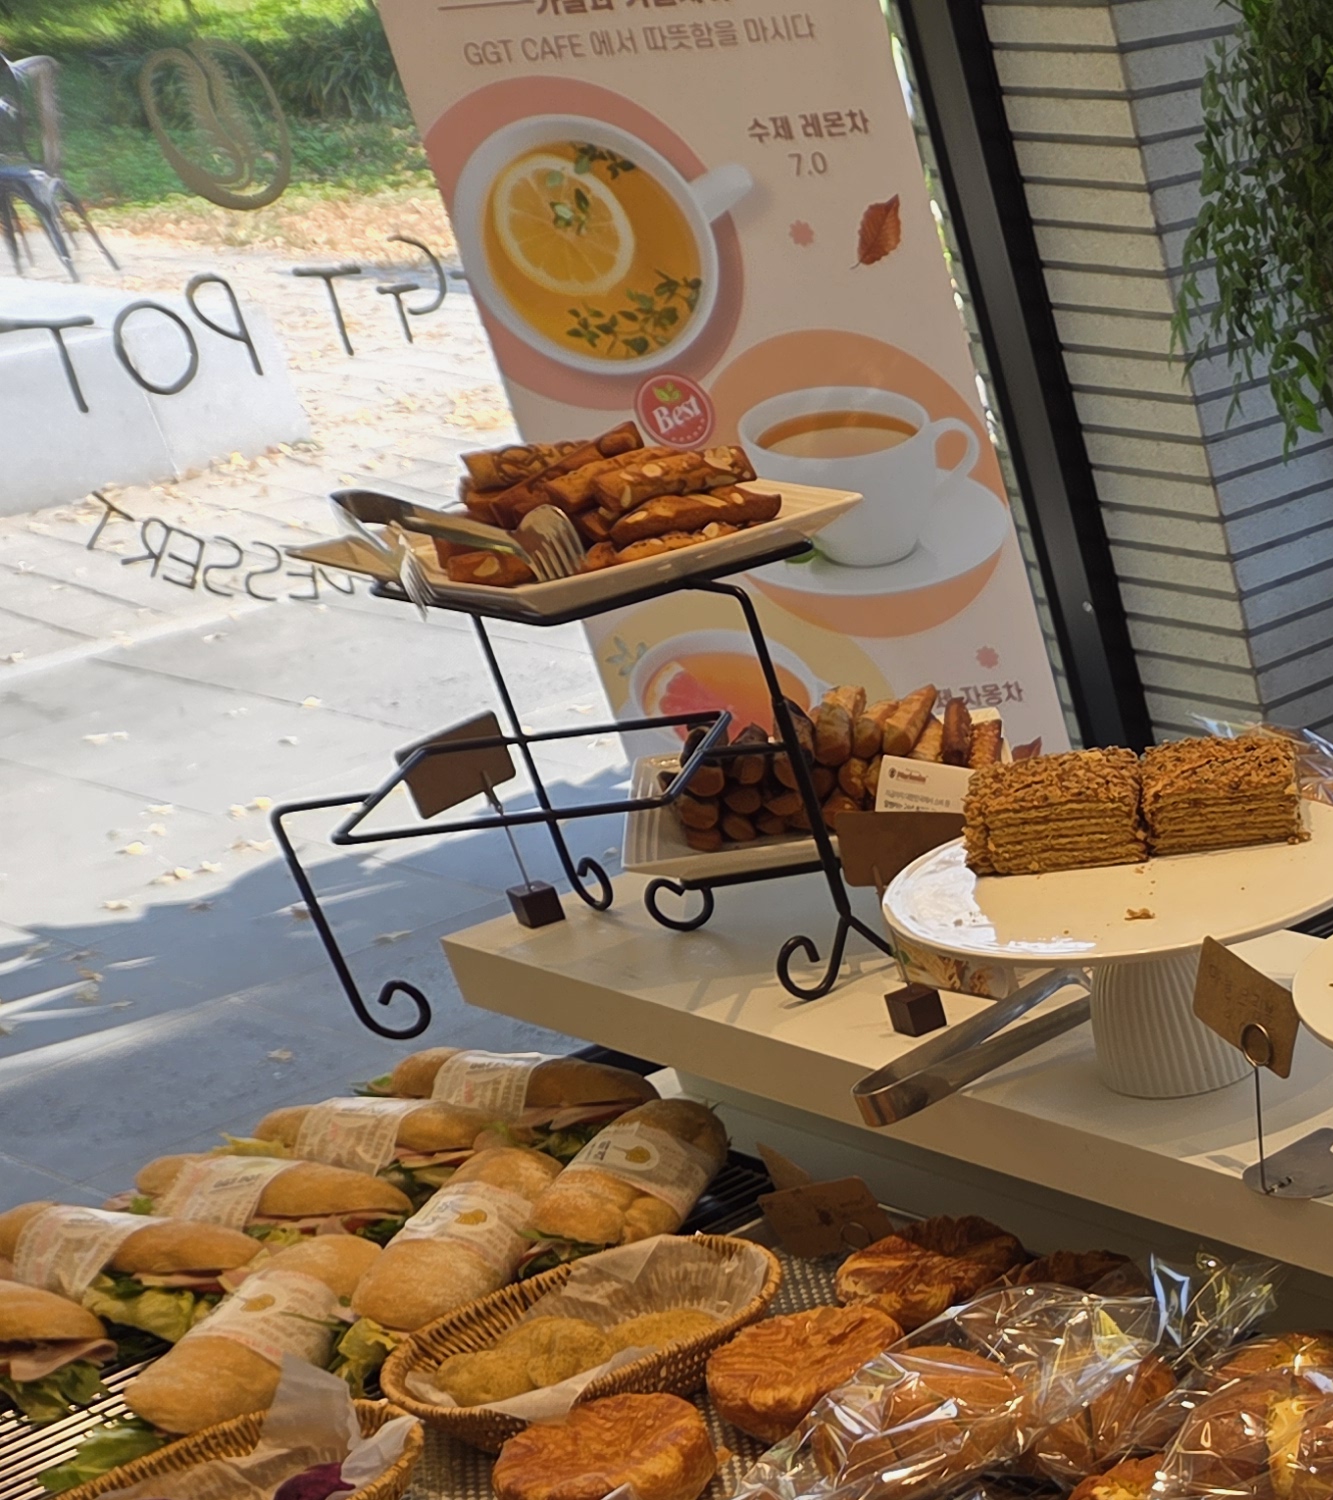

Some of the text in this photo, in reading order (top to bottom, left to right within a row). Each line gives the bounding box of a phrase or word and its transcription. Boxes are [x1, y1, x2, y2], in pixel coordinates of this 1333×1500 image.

[463, 13, 815, 66] GGT CAFE 에서 따뜻함을 마시다
[747, 109, 870, 143] 수제 레몬차
[787, 151, 829, 178] 7.0
[652, 395, 701, 434] Best
